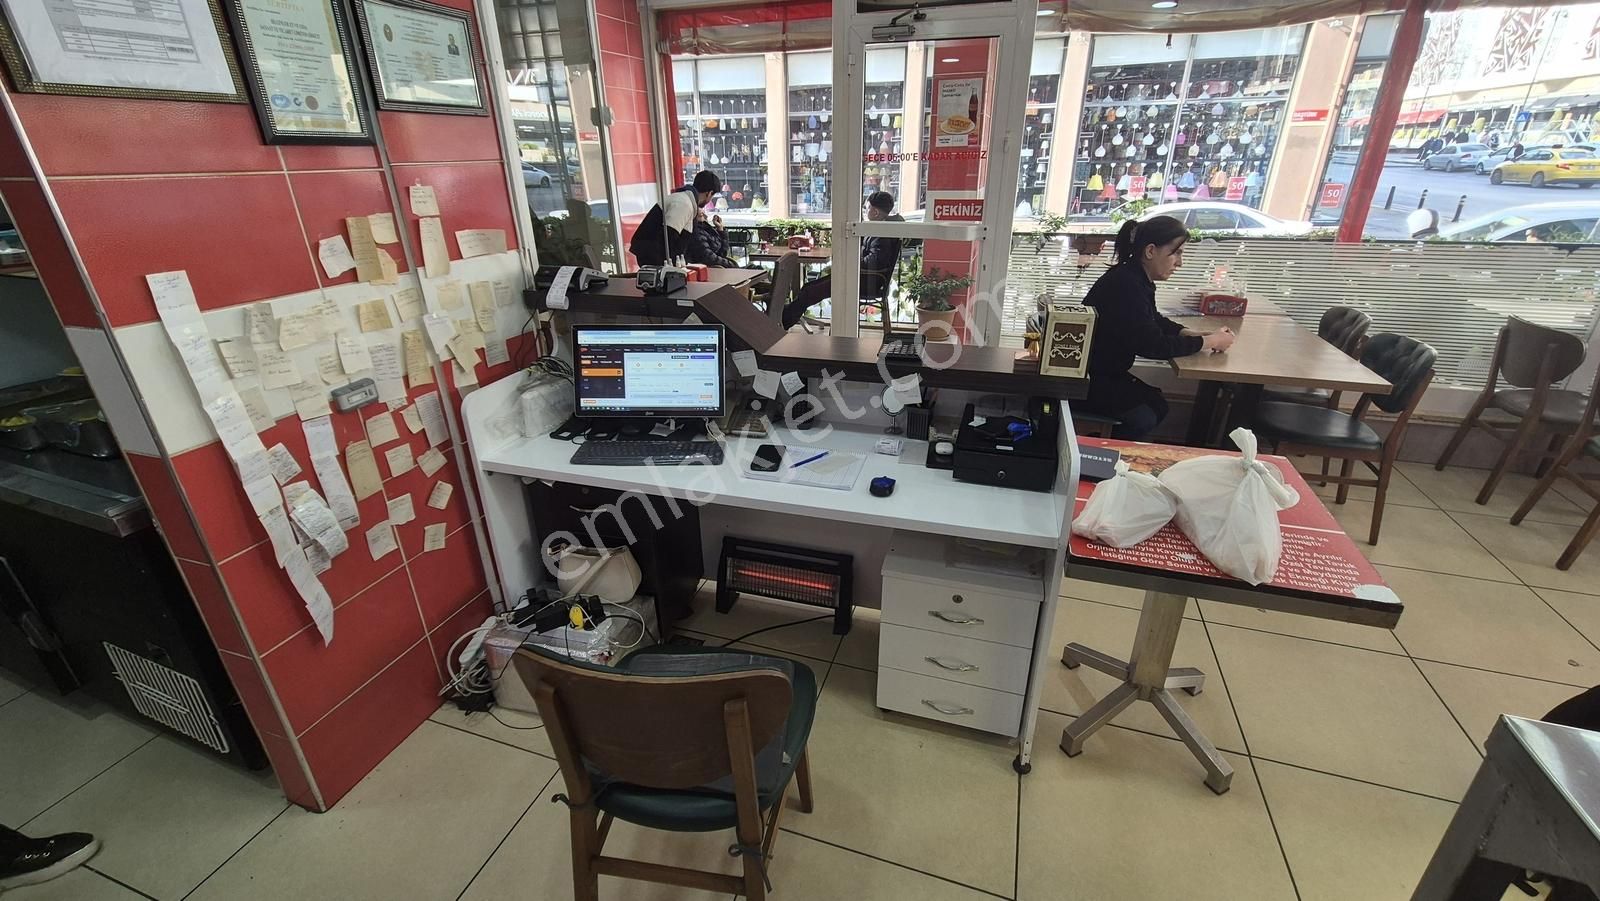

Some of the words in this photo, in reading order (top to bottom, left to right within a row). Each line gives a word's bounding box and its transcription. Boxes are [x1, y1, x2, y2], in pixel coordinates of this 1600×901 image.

[863, 153, 886, 162] GECE
[921, 151, 954, 161] KADAR
[934, 203, 982, 218] ÇEKİNİZ
[1326, 559, 1358, 569] Tavuk
[1302, 567, 1359, 582] Maydanoz
[1289, 578, 1353, 594] Hazırlanıyo
